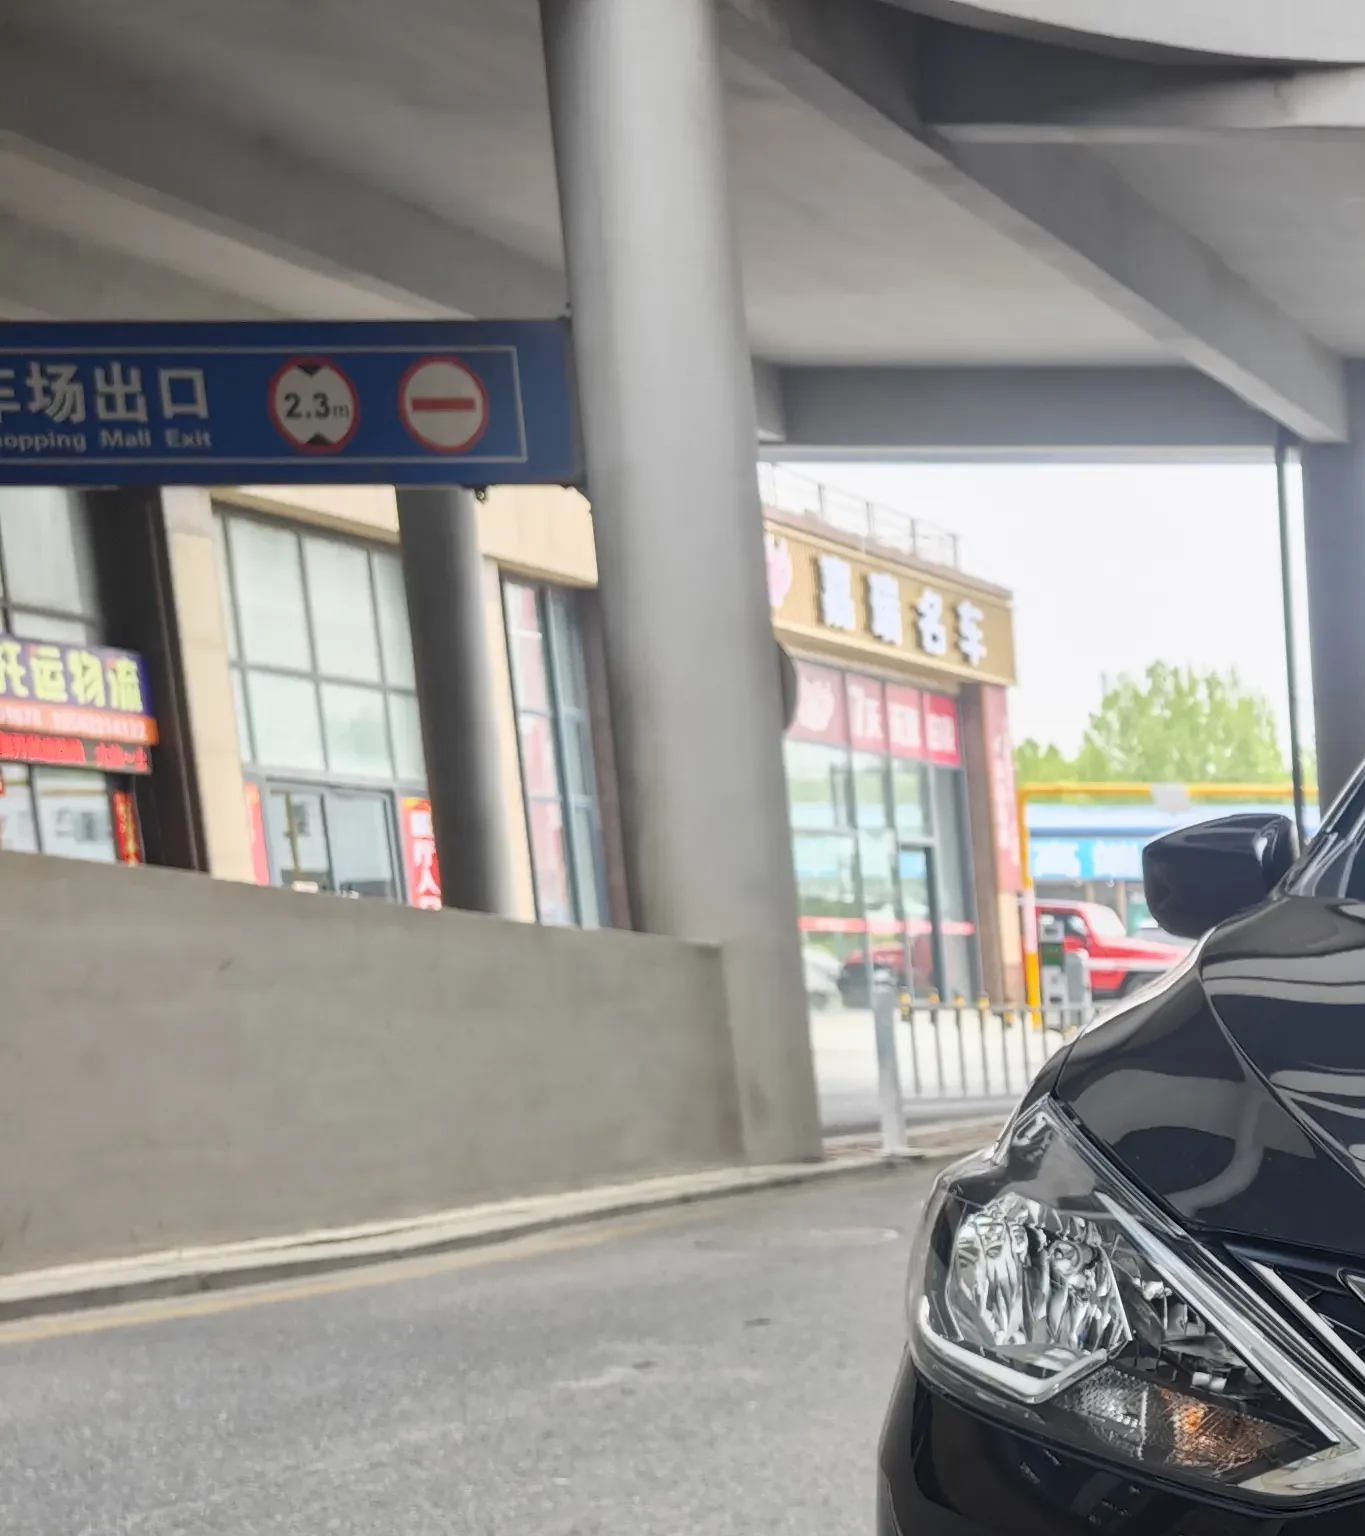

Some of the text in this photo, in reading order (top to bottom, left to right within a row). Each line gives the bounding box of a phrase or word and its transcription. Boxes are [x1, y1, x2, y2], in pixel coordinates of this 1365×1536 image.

[284, 392, 350, 419] 2.3m
[101, 428, 151, 448] Mall
[165, 428, 212, 448] Exit
